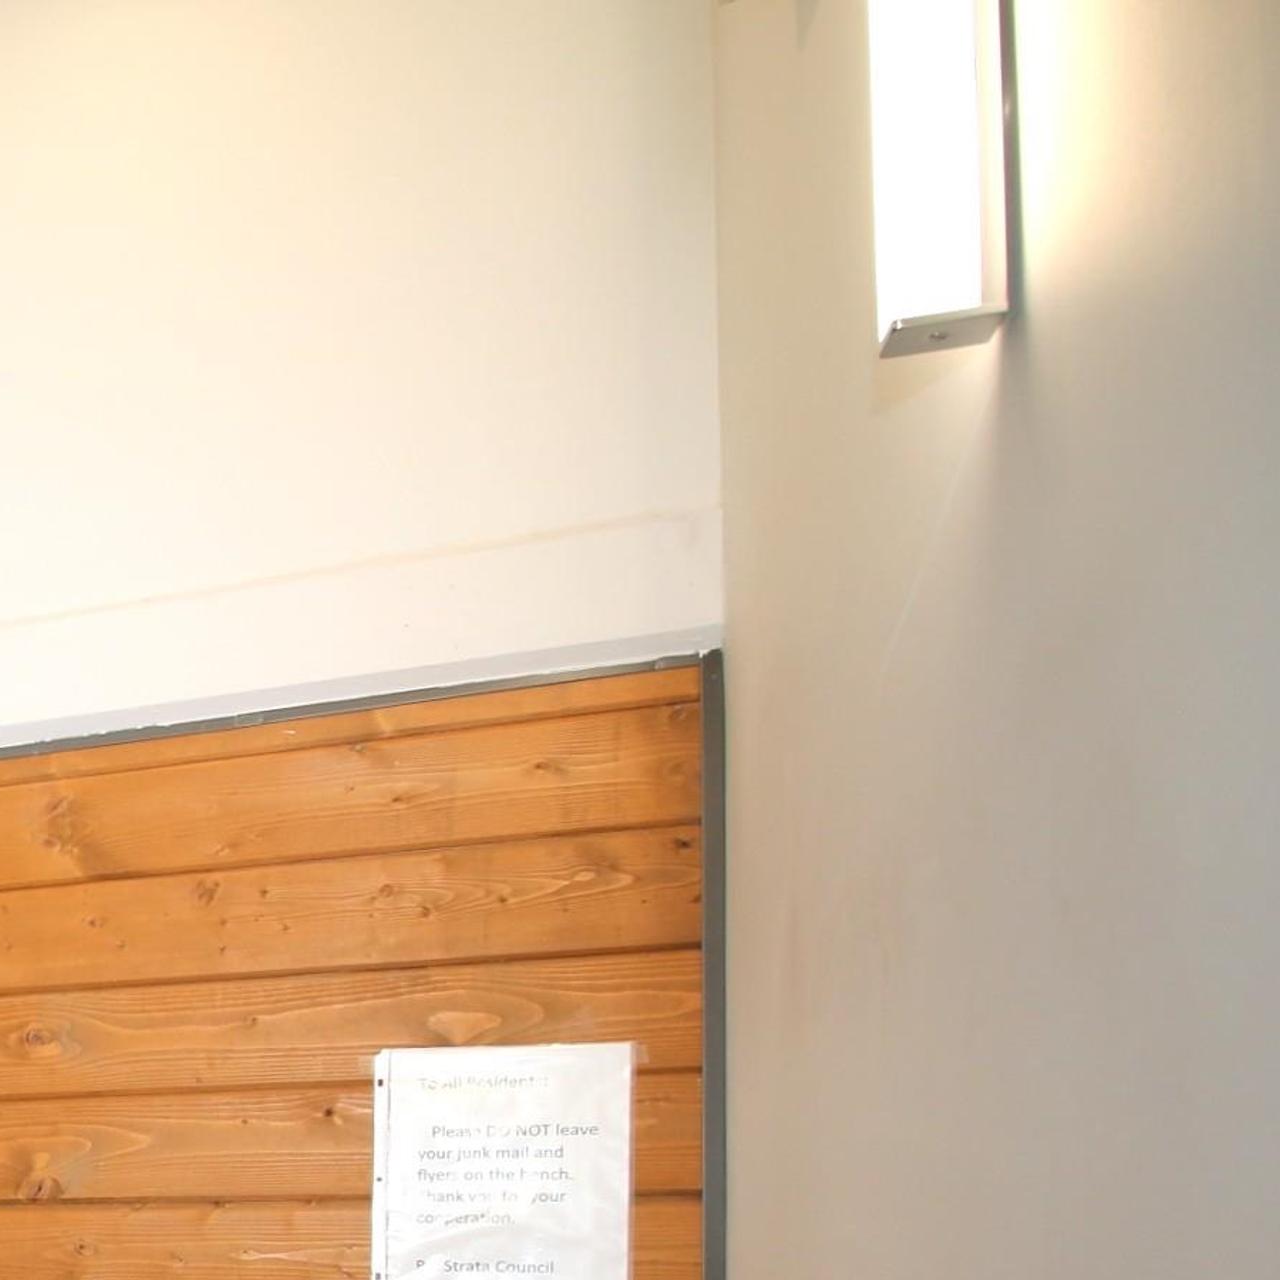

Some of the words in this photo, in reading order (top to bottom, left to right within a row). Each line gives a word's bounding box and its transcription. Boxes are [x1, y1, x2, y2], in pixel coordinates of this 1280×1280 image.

[431, 1125, 481, 1138] Pleas
[516, 1123, 551, 1137] NOT
[556, 1122, 600, 1137] leave
[418, 1149, 452, 1162] your
[456, 1146, 490, 1161] junk
[496, 1146, 529, 1159] mail
[534, 1146, 565, 1159] and
[418, 1168, 454, 1183] flyer
[464, 1171, 483, 1181] on
[490, 1168, 515, 1181] the
[422, 1189, 465, 1202] hank
[495, 1259, 555, 1275] Council
